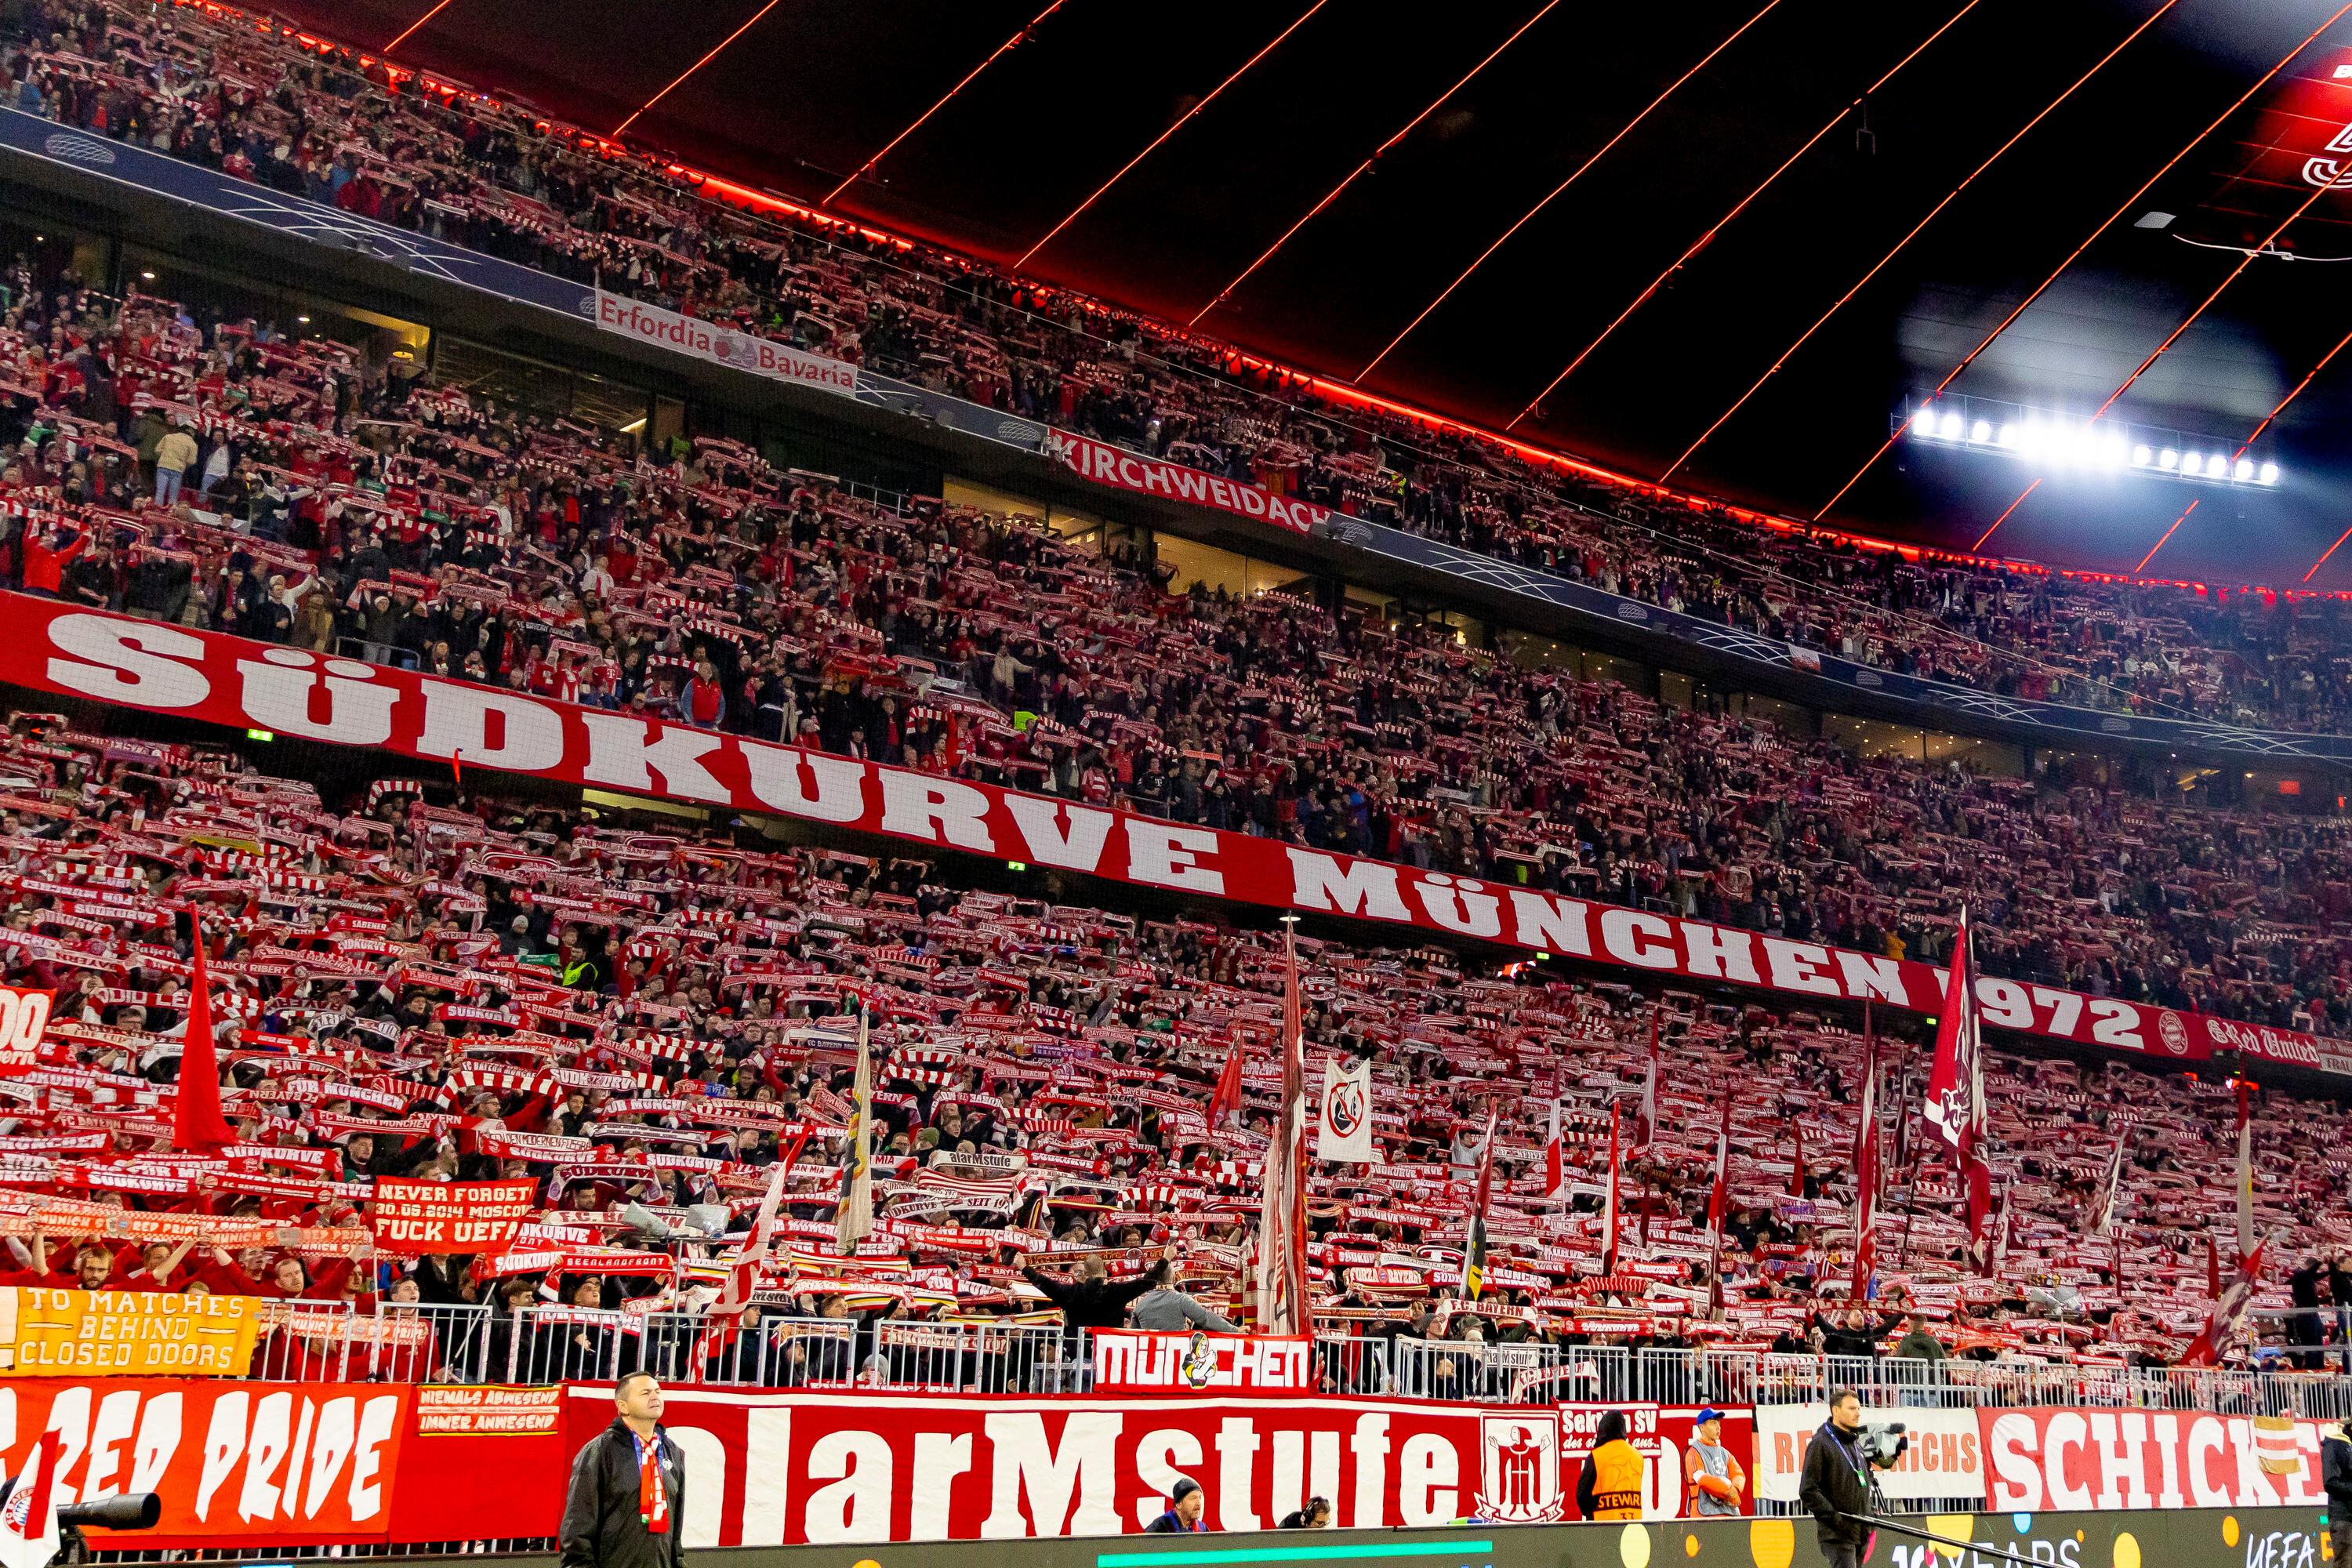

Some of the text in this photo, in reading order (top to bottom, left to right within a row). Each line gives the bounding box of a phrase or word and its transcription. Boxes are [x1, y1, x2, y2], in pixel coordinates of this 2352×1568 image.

[601, 297, 854, 389] Erfordia Bavaria
[1055, 433, 1330, 532] KIRCHWEIDACH
[47, 613, 2144, 1050] SÜDKURVE MÜNCHEN 972
[2259, 1028, 2321, 1063] United
[1111, 1069, 1156, 1080] BAYERN
[336, 1113, 378, 1127] BAYERN
[949, 1151, 1011, 1167] alarMstufe
[379, 1185, 448, 1202] NEVER
[376, 1218, 517, 1241] FUCK UEFA
[566, 1257, 665, 1267] SEENLANDFRONT
[26, 1287, 245, 1319] TO MATCHES
[1451, 1301, 1524, 1317] F.C. BAYERN
[78, 1316, 190, 1341] BEHIND
[20, 1341, 234, 1369] CLOSED DOORS
[421, 1390, 560, 1405] NIEMALS ABWESEND
[419, 1414, 556, 1430] IMMER ANWESEND
[1562, 1410, 1657, 1434] Sekn SV
[194, 1390, 399, 1524] PRIDE
[1991, 1411, 2329, 1512] SCHICKE
[1943, 1538, 2082, 1568] YEARS
[2245, 1531, 2314, 1568] UEFA
